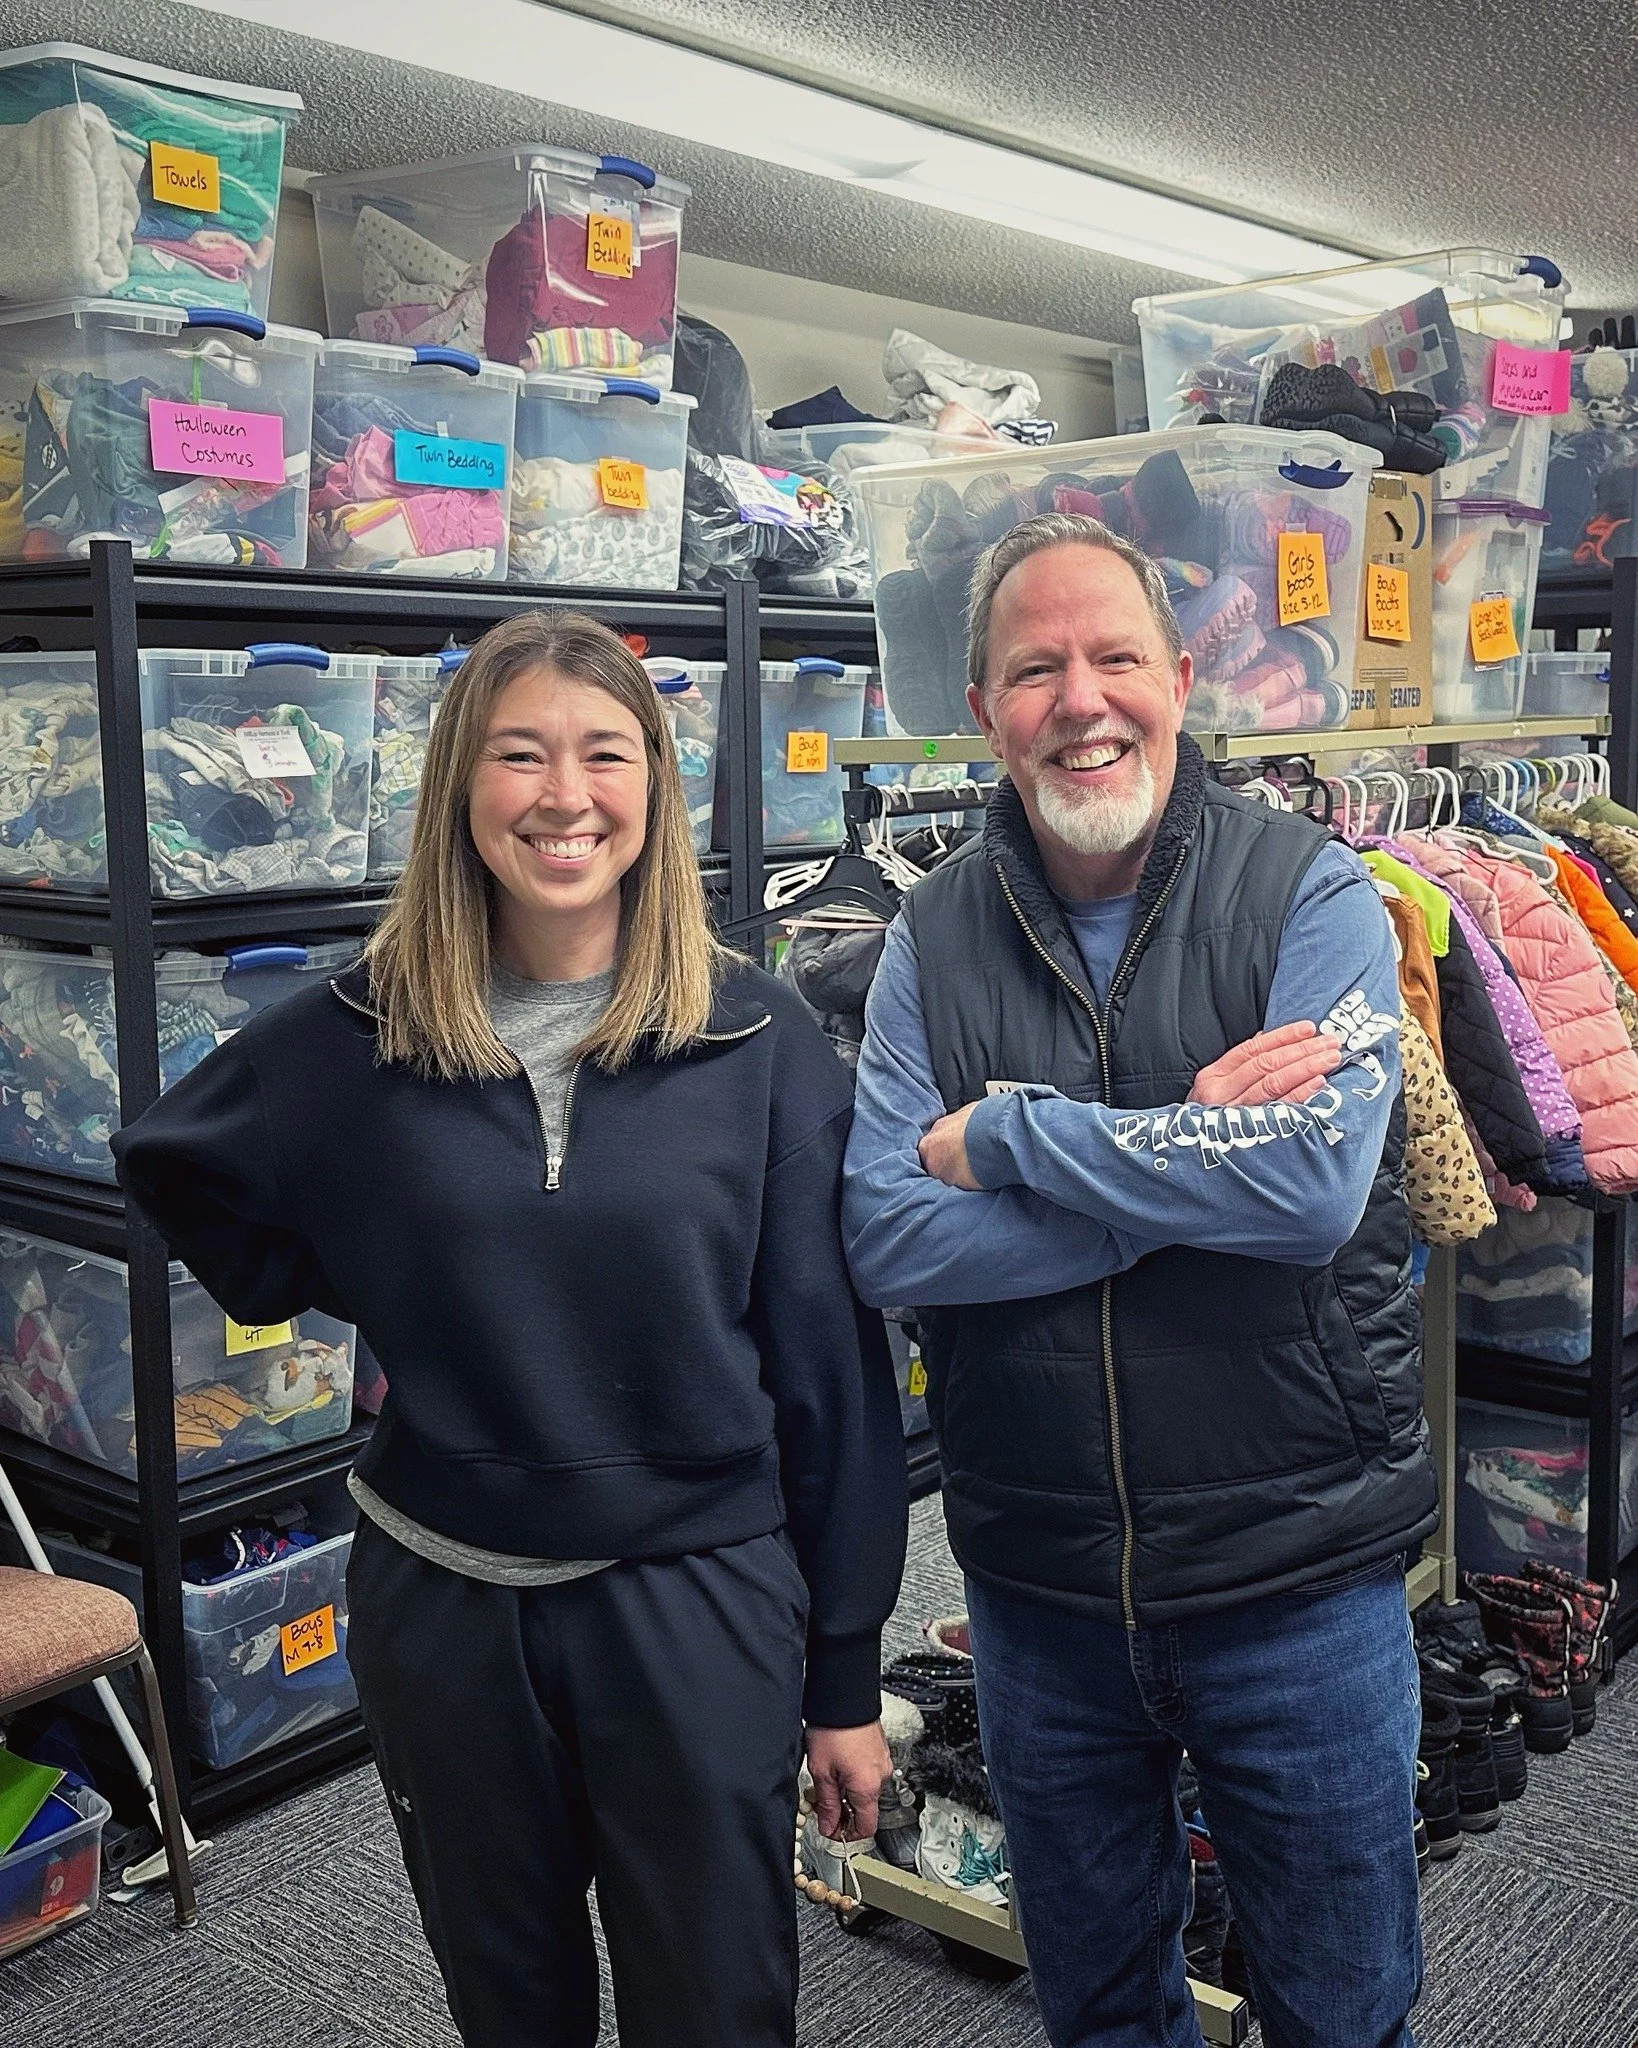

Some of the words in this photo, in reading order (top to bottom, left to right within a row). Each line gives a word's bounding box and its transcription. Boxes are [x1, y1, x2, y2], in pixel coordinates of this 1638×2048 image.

[160, 165, 207, 190] Towels
[594, 221, 622, 240] Twin
[593, 242, 631, 274] Bedding
[174, 412, 247, 437] Halloween
[181, 442, 254, 467] Costumes
[415, 445, 444, 463] Twin
[447, 449, 495, 477] Bedding
[607, 465, 632, 482] Twin
[1288, 546, 1315, 575] Girls
[1377, 574, 1397, 600] Boys
[1350, 689, 1365, 710] EEP
[799, 736, 819, 757] Boys
[245, 1328, 264, 1343] 4T
[290, 1614, 324, 1642] Boys
[285, 1647, 301, 1665] M
[301, 1635, 324, 1653] 7-8
